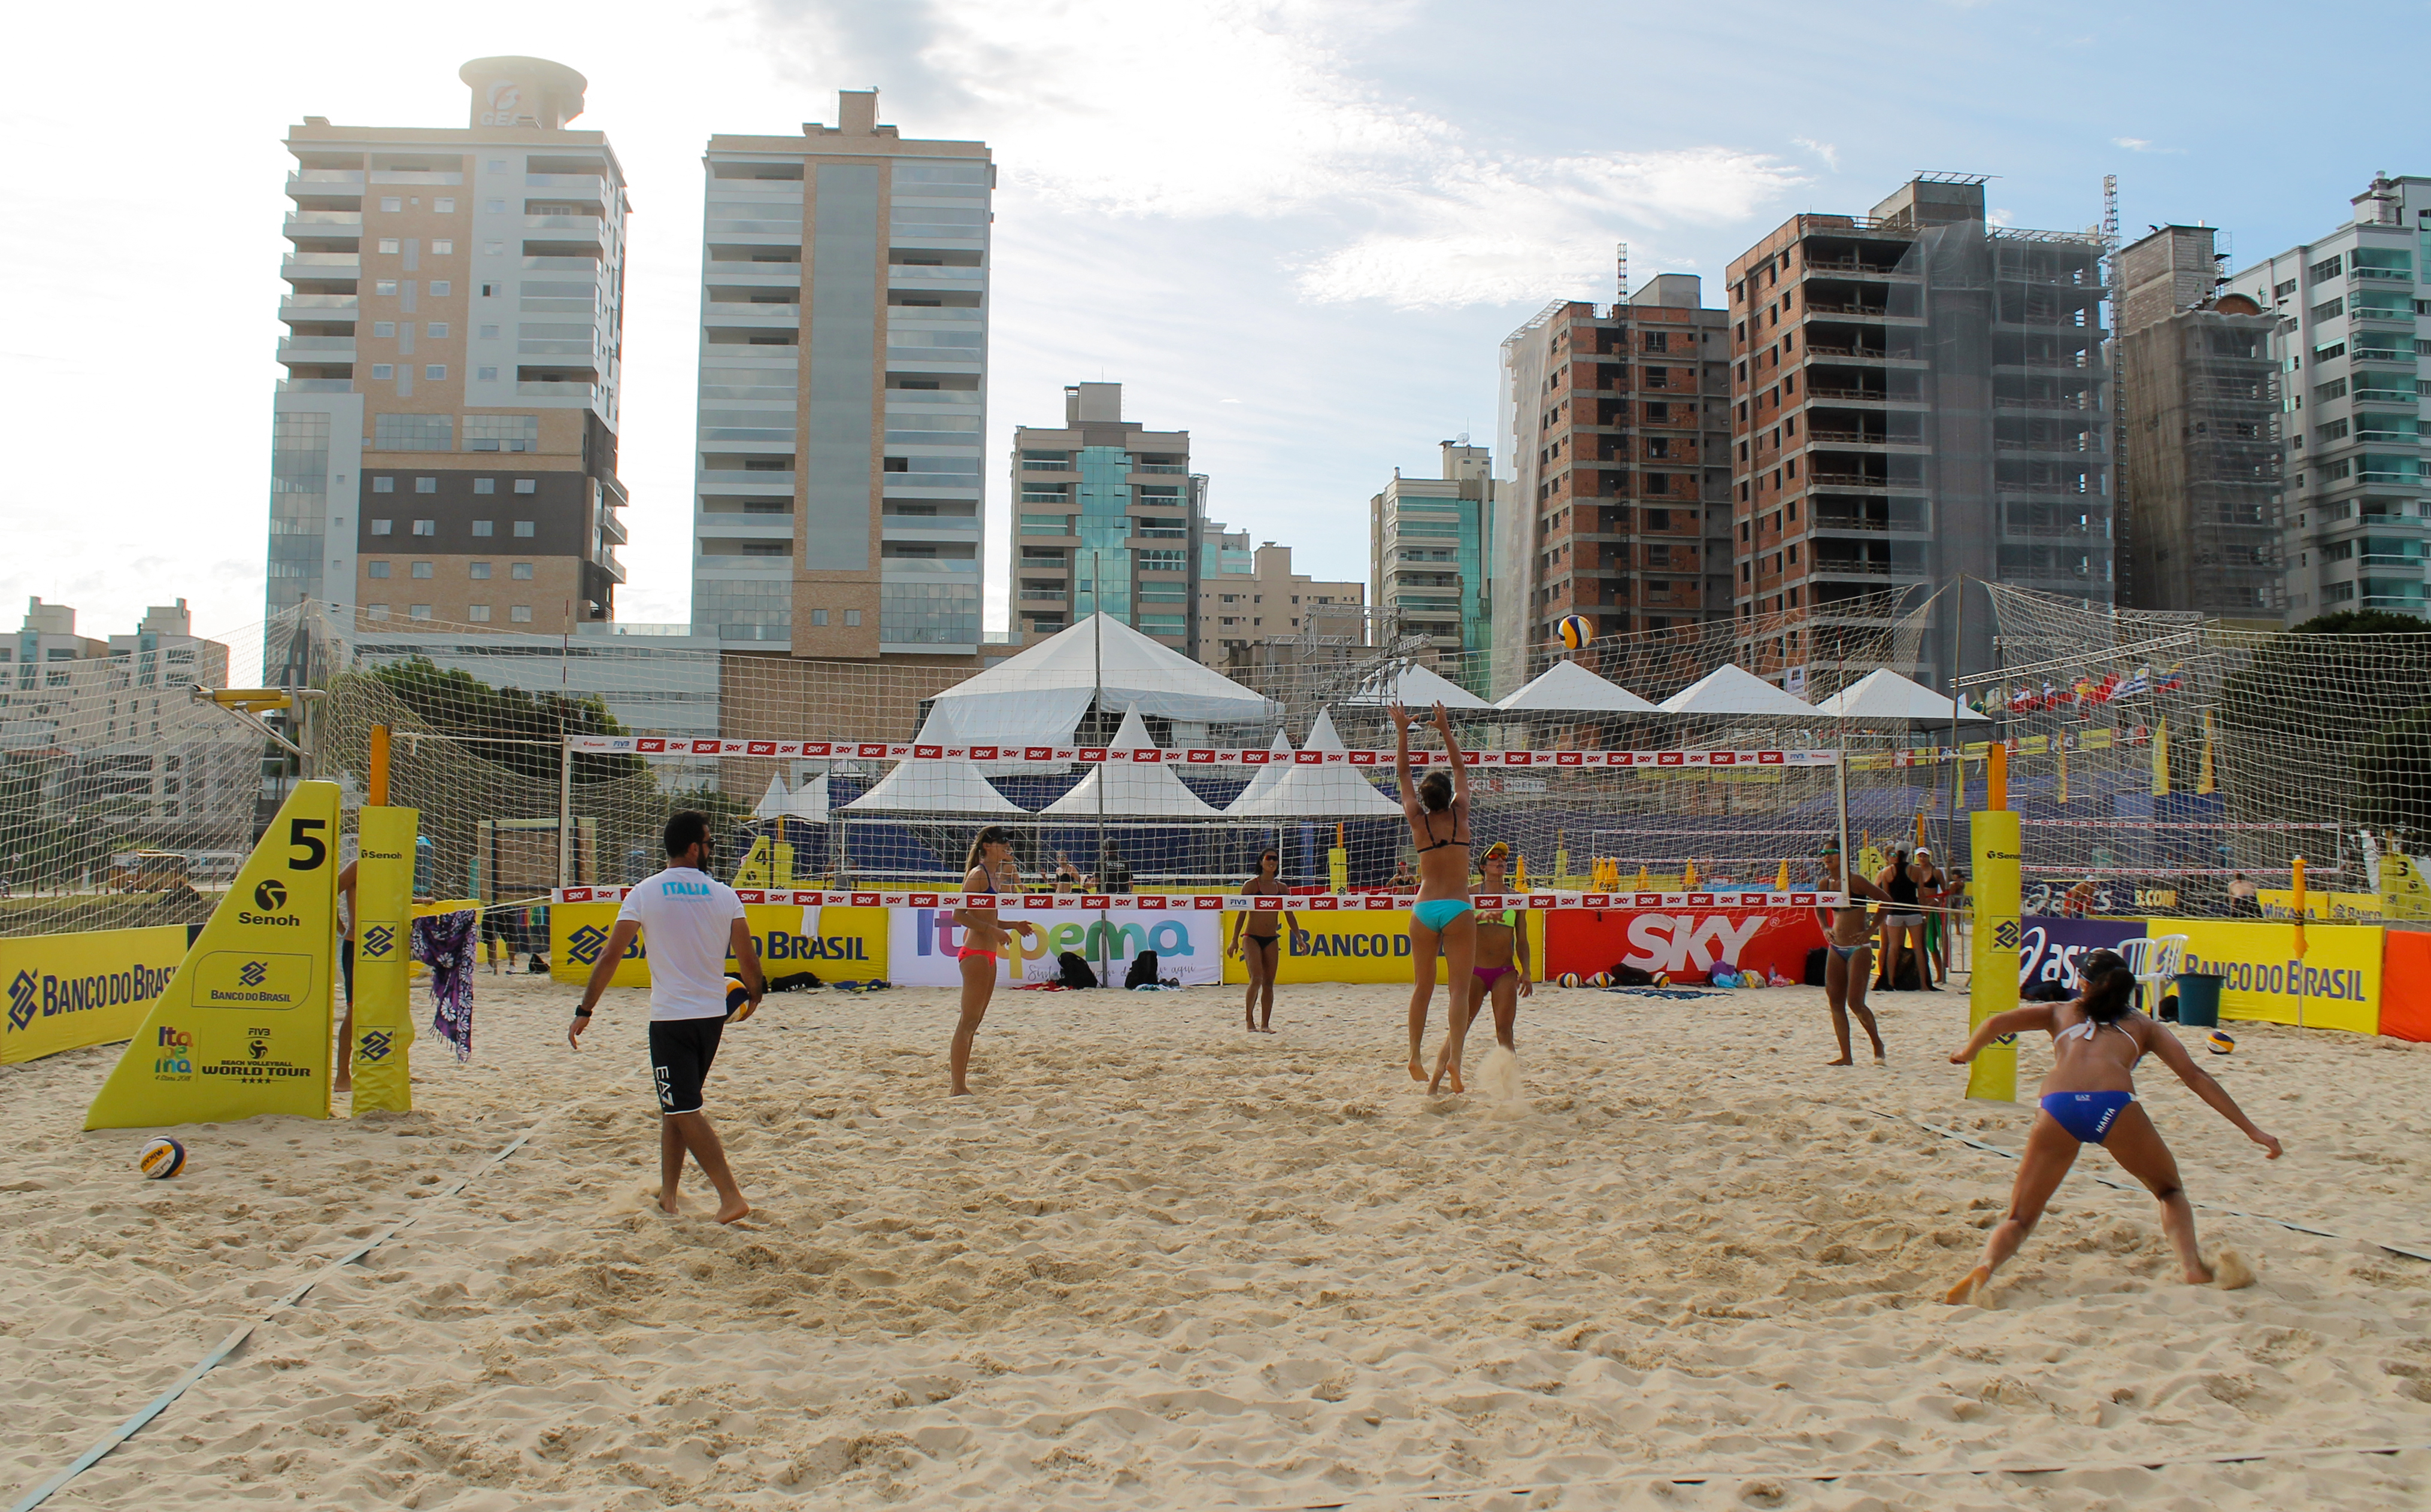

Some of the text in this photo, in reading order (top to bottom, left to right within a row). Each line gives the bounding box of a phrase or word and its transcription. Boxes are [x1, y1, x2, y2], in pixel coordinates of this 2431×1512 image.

[1433, 754, 1449, 763] SKY
[289, 818, 326, 871] 5
[368, 851, 403, 859] Senoh
[755, 848, 768, 865] 4
[1871, 854, 1878, 863] 2
[1997, 851, 2020, 860] Seno
[2397, 861, 2408, 876] 3
[568, 891, 586, 900] SKY
[662, 882, 711, 896] ITALIA
[2264, 899, 2315, 919] MIKAA
[238, 912, 300, 926] Senoh
[768, 931, 869, 960] BRASIL
[918, 909, 1195, 979] Itpema
[1289, 928, 1388, 957] BANCO
[1393, 934, 1411, 957] D
[1620, 913, 1769, 972] SKY
[2255, 964, 2283, 994] DO
[2287, 960, 2366, 1002] BRASIL
[43, 964, 179, 1017] BANCO DO BRAS
[211, 990, 243, 1001] BANCO
[259, 991, 292, 1002] BRASIL
[158, 1026, 193, 1047] Ita
[248, 1028, 271, 1036] FIVB
[202, 1065, 311, 1077] WORLD TOUR
